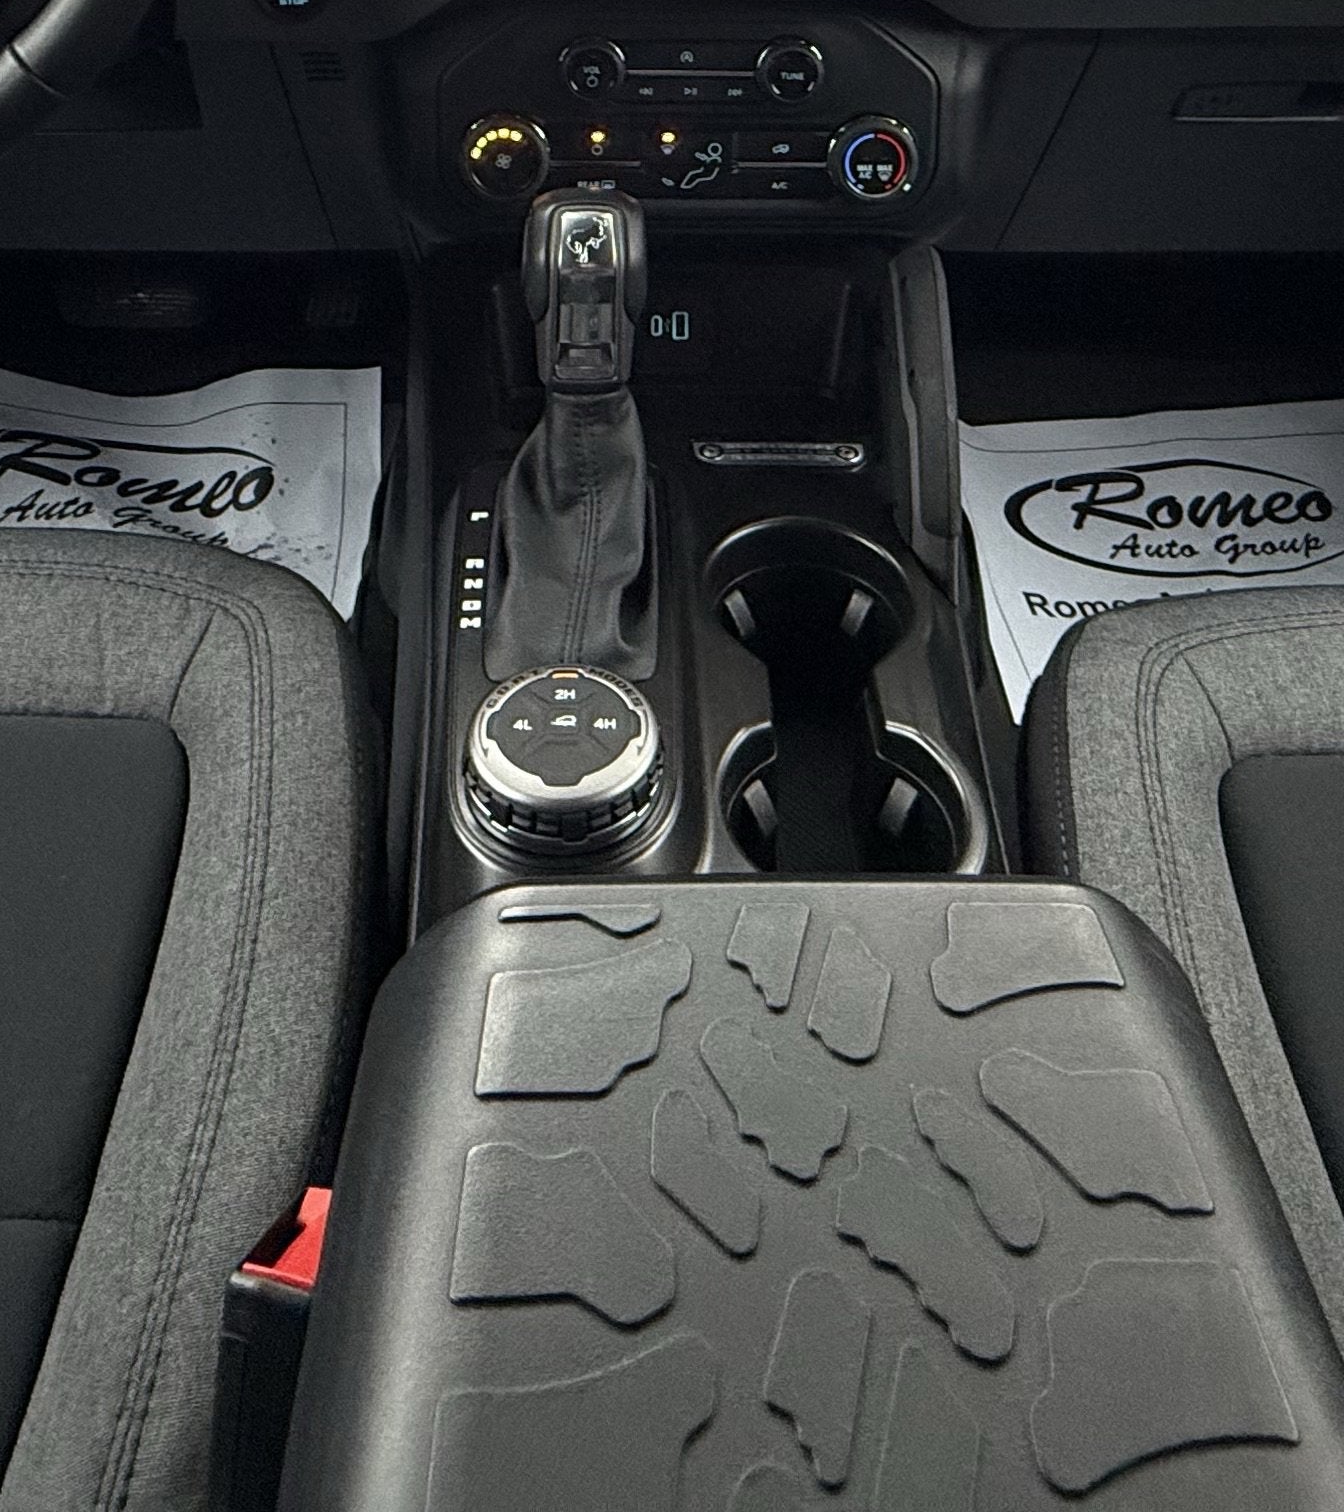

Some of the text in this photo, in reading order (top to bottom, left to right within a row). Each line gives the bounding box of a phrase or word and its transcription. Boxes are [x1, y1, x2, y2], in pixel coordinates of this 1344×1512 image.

[583, 66, 600, 74] VOL
[780, 72, 805, 80] TUNE
[771, 181, 788, 189] A/C
[1053, 471, 1334, 530] Romeo
[1109, 533, 1326, 564] Auto Group
[460, 617, 482, 630] M
[554, 688, 576, 701] 2H
[512, 718, 533, 731] 4L
[593, 717, 617, 730] 4H
